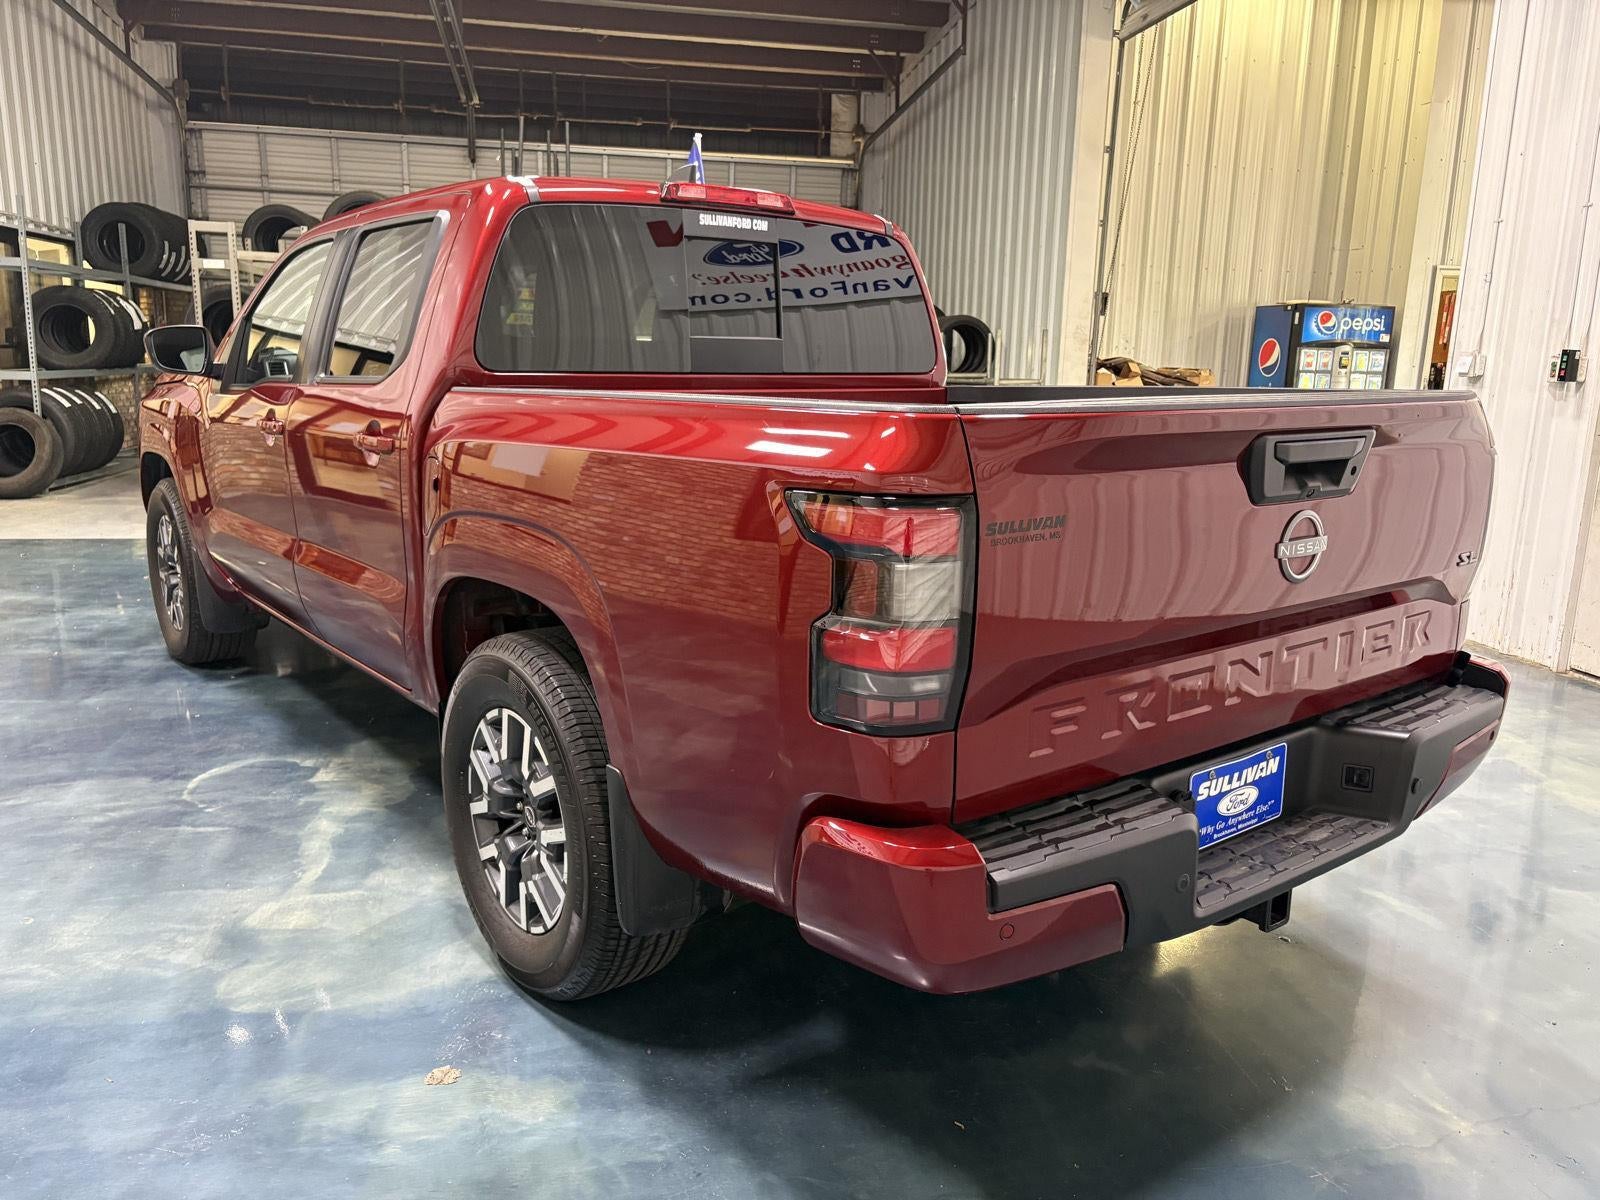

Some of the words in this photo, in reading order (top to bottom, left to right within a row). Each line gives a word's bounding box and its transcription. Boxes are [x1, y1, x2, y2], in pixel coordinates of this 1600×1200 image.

[1340, 315, 1386, 335] pepsi
[985, 515, 1067, 536] SULLIVAN
[990, 532, 1047, 547] BROOKHAVEN,
[1049, 531, 1061, 540] MS
[1280, 538, 1328, 557] NISSAN
[1028, 609, 1433, 758] FRONTIER
[1197, 756, 1280, 801] SULLIVAN
[1226, 791, 1251, 811] Ford
[1216, 820, 1226, 830] Go
[1226, 809, 1255, 827] Anywhere
